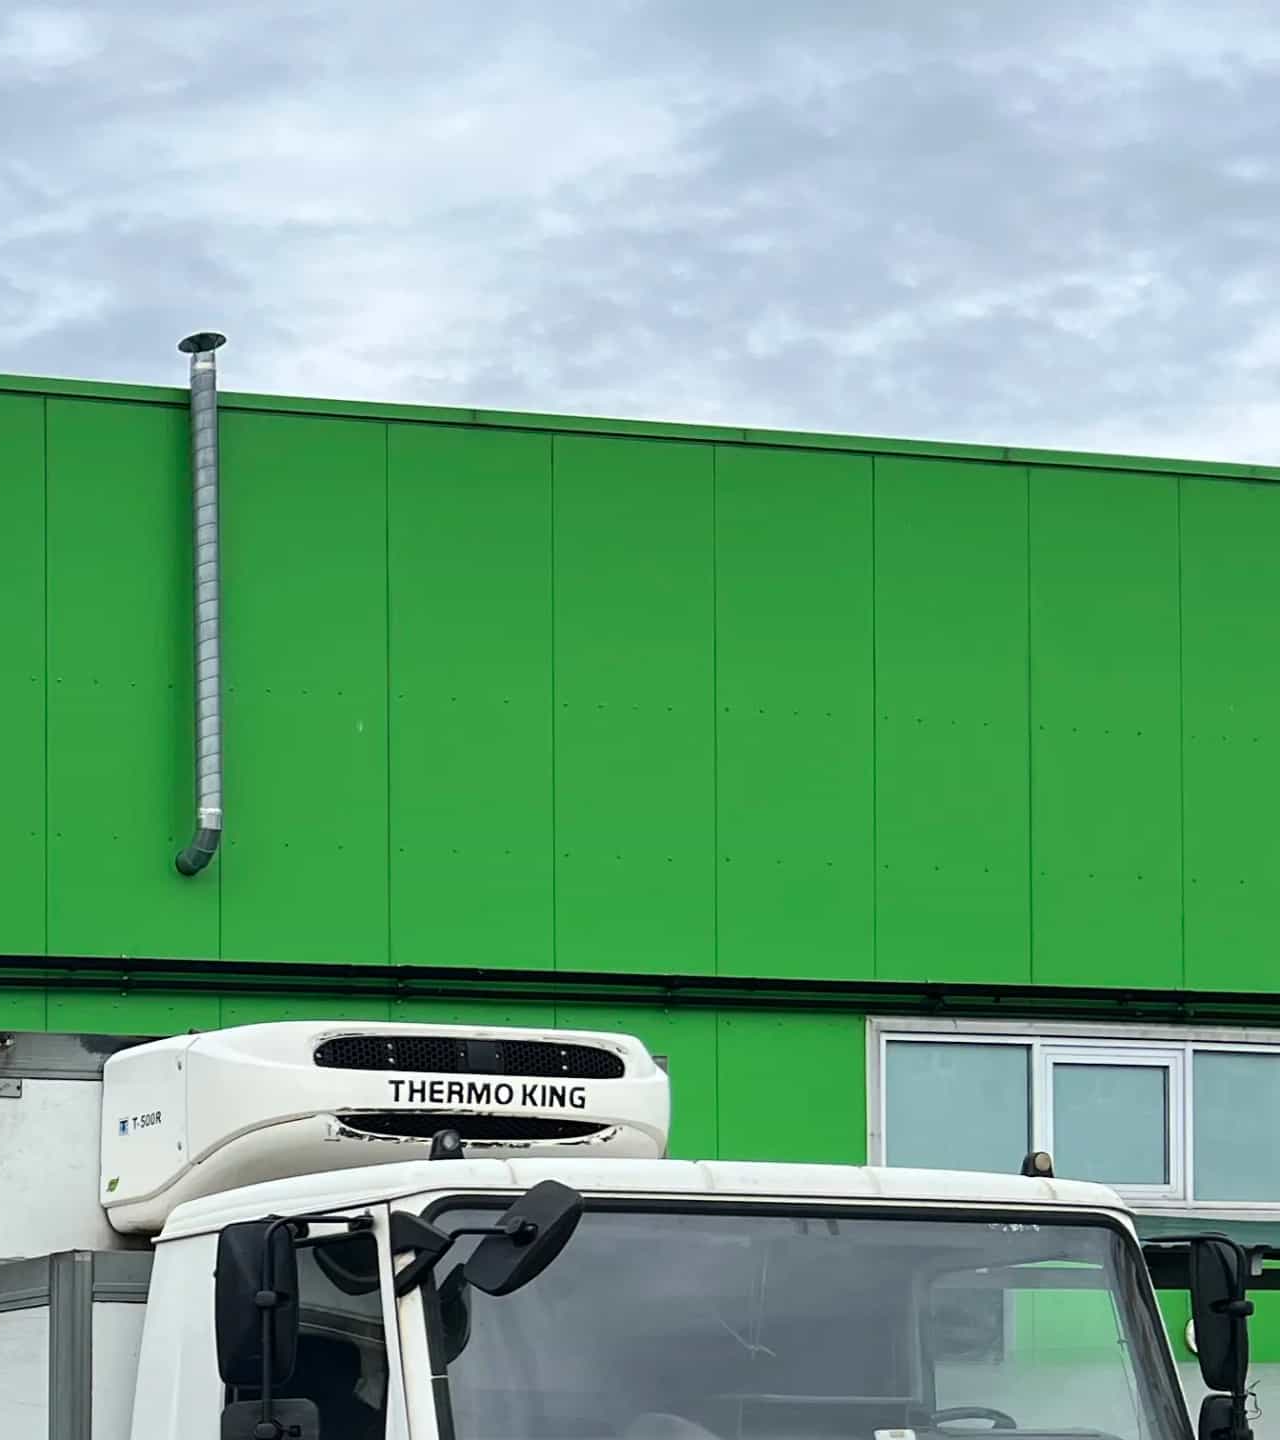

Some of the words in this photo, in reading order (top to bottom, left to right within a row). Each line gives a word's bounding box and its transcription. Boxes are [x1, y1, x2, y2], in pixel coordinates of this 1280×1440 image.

[389, 1079, 514, 1105] THERMO
[521, 1083, 586, 1109] KING
[132, 1110, 162, 1130] T-500R
